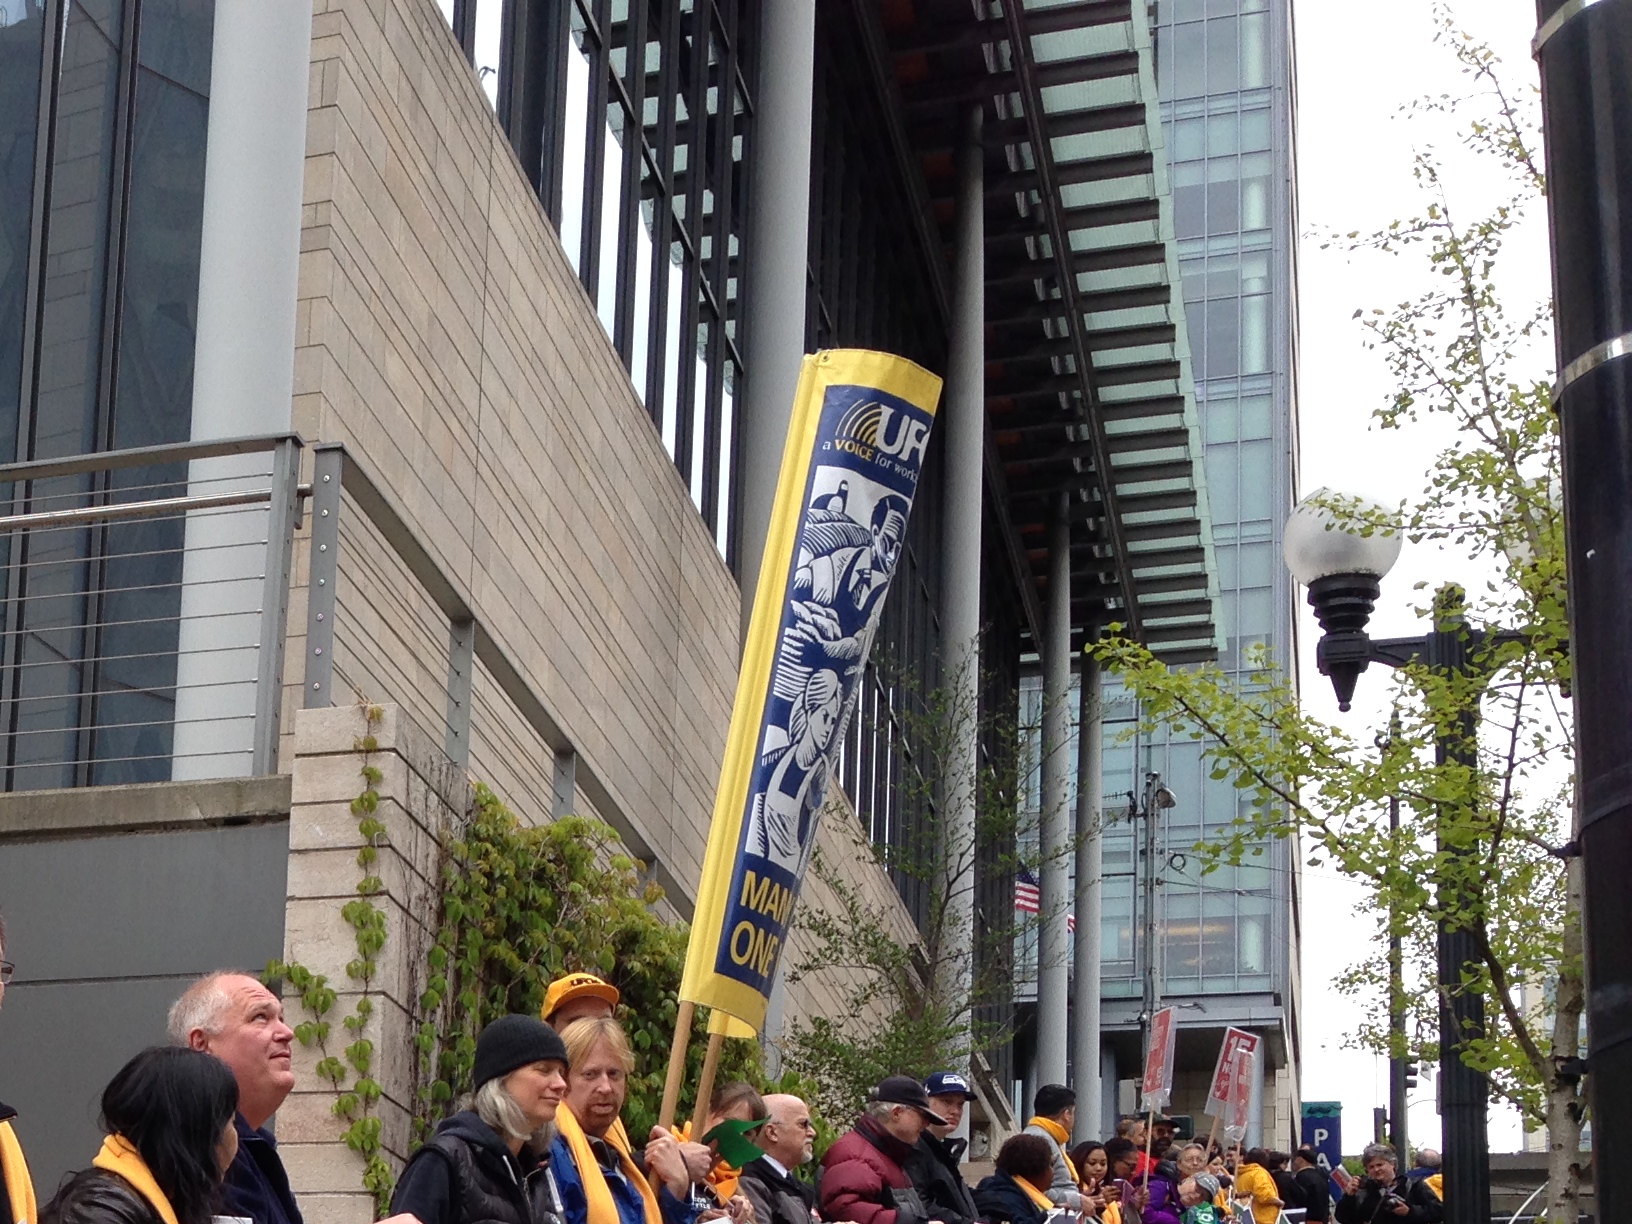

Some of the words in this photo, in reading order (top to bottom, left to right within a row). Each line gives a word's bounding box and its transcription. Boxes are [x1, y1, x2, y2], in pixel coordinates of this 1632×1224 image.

[822, 441, 831, 450] a
[835, 439, 874, 461] VOICE
[874, 452, 892, 469] for
